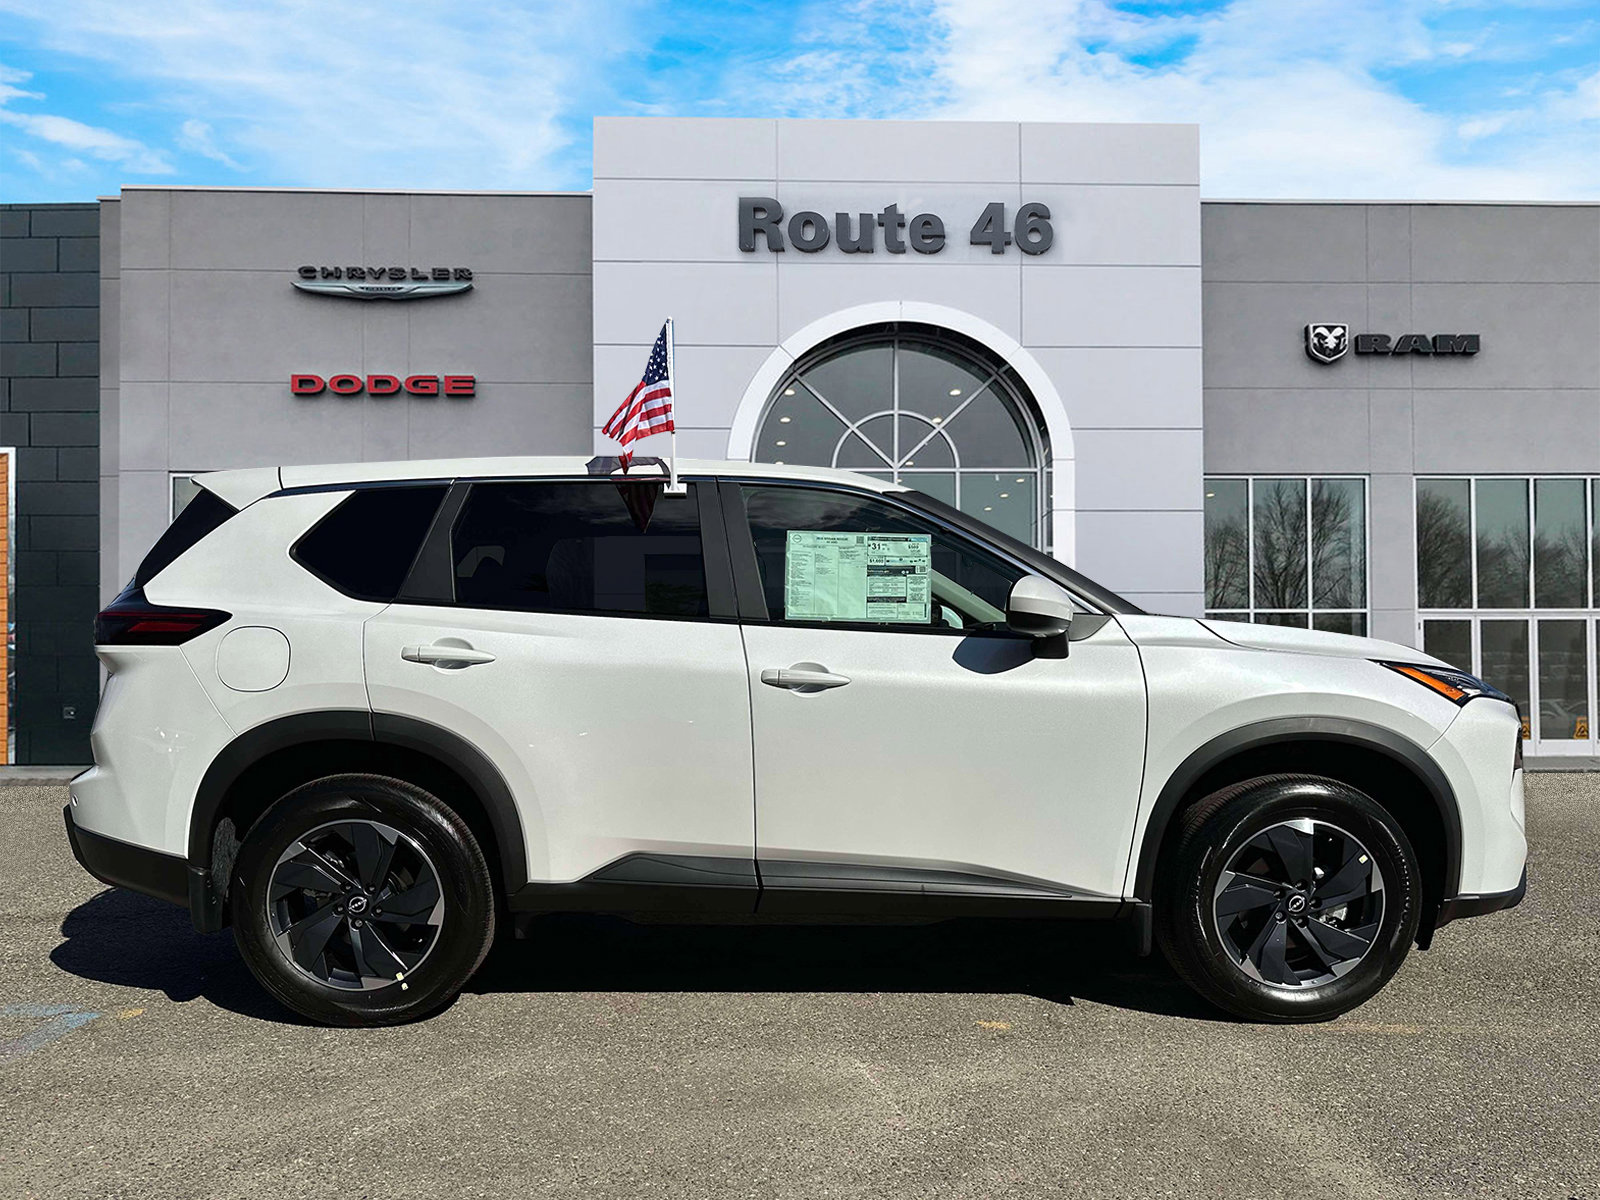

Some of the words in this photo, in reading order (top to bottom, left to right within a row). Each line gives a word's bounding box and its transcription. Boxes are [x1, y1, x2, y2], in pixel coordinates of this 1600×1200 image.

[738, 197, 946, 254] Route
[970, 202, 1054, 255] 46
[298, 266, 473, 280] CHRYSLER
[1355, 334, 1480, 355] RAM
[291, 374, 476, 396] DODGE
